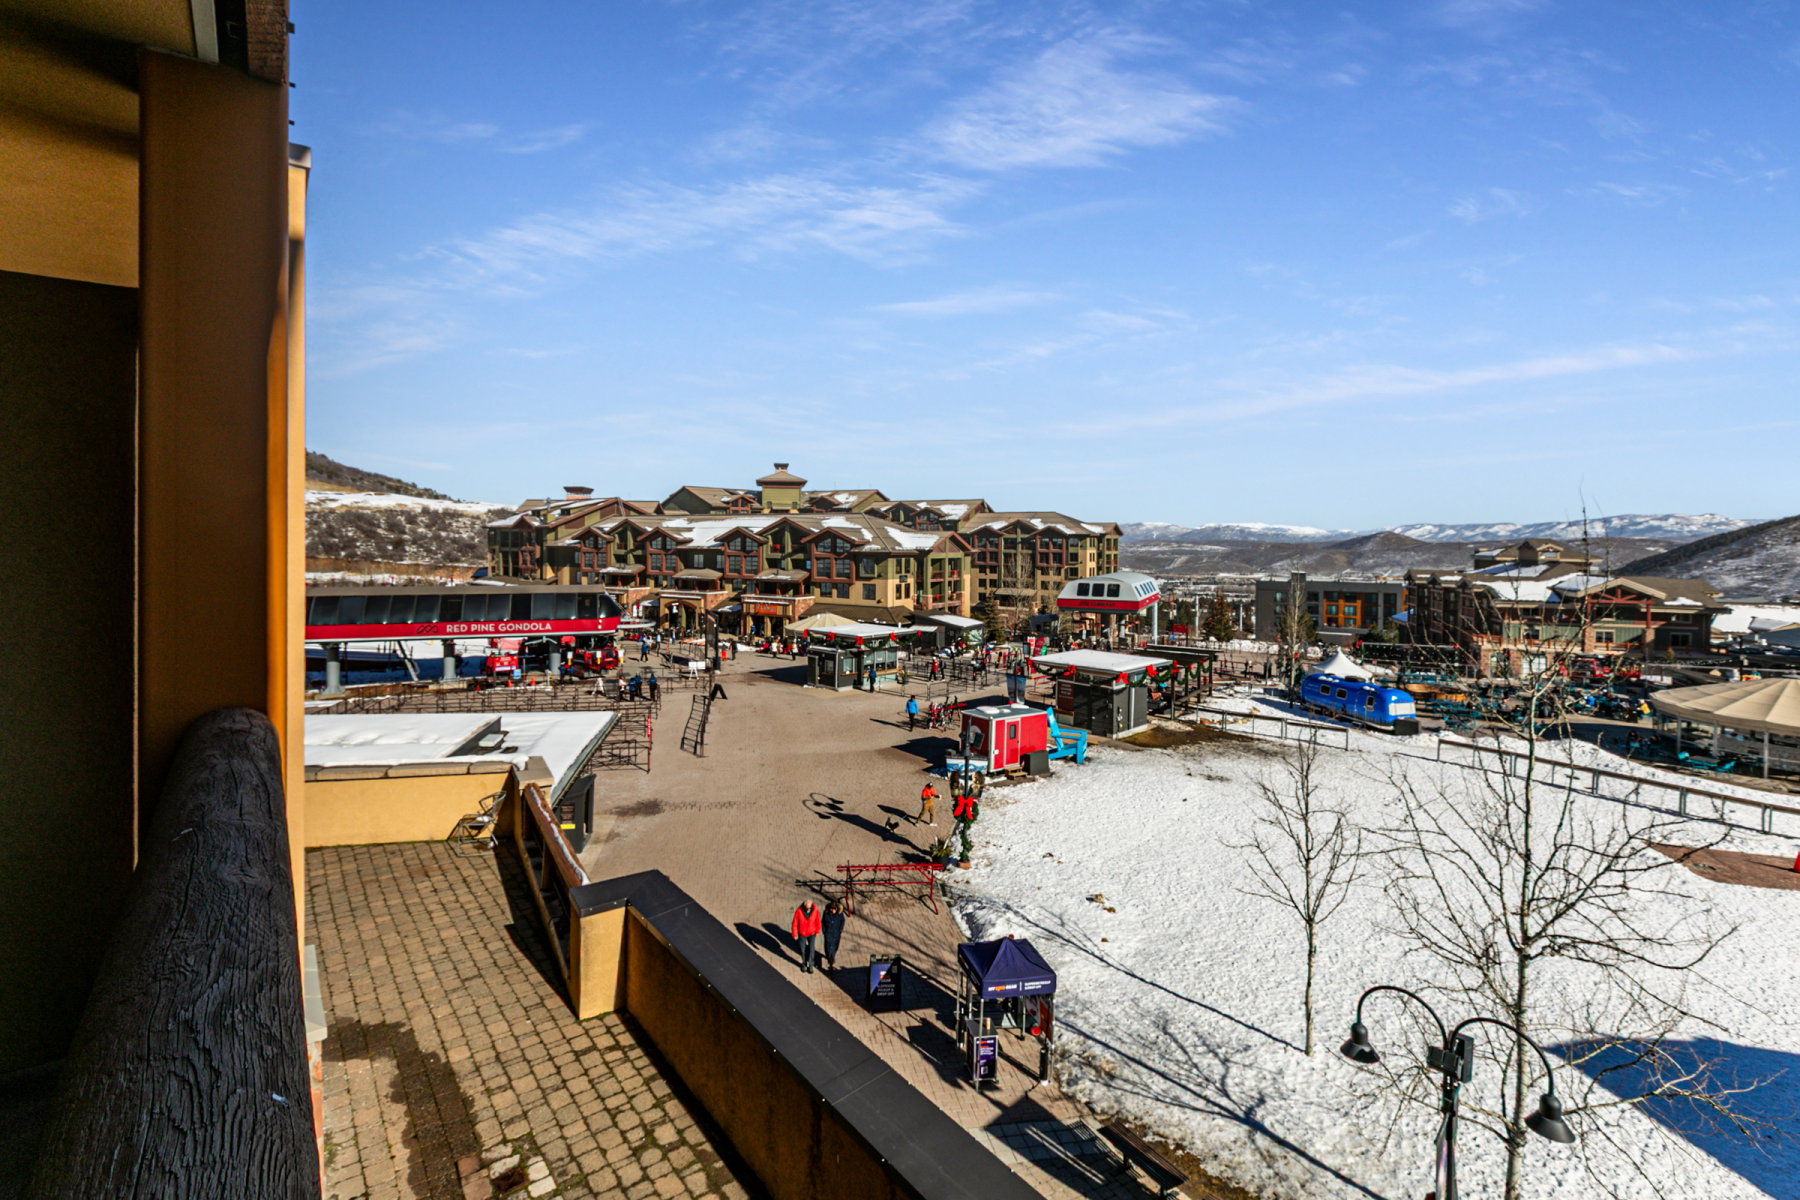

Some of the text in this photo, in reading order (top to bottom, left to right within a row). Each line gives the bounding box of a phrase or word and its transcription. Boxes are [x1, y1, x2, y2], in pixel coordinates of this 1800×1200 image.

[446, 622, 552, 633] RED PINE GONDOLA
